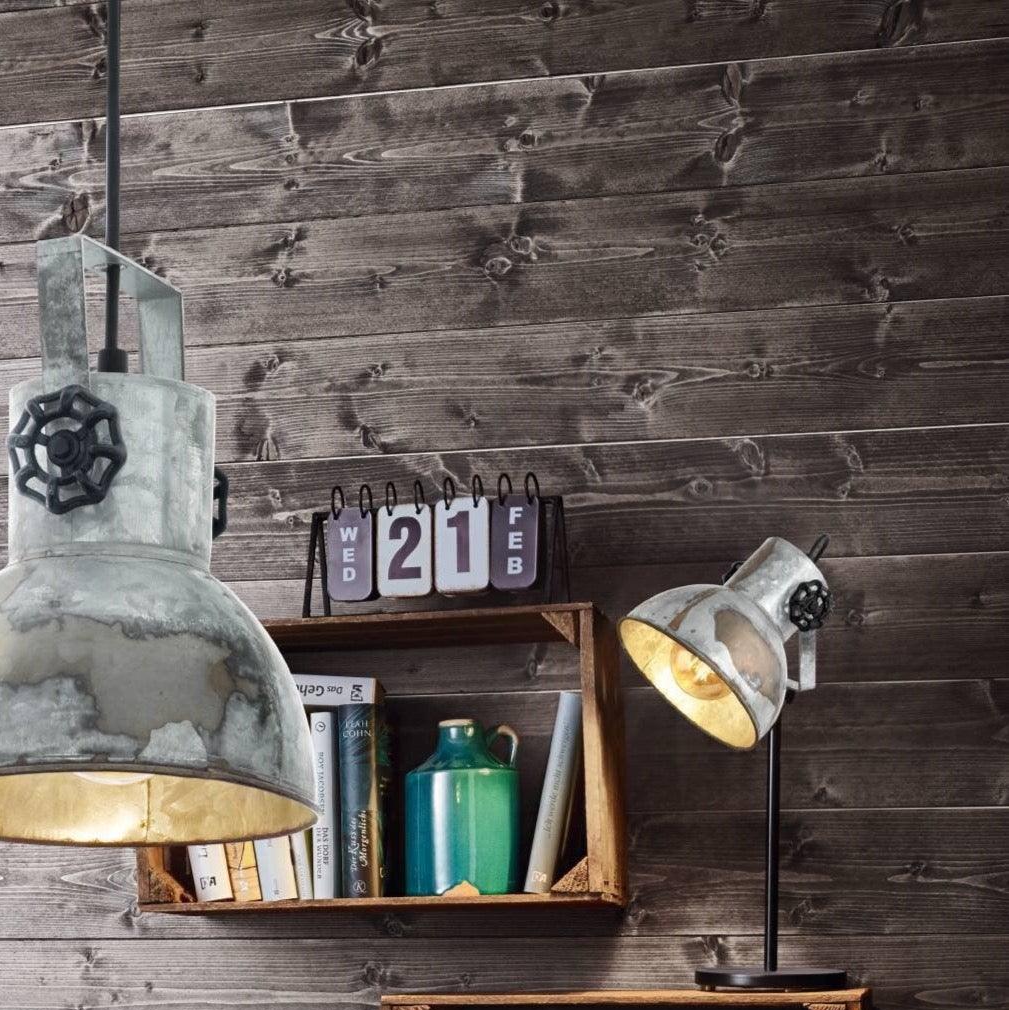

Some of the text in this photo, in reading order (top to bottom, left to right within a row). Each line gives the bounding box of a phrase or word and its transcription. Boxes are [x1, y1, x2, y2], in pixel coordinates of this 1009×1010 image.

[340, 526, 359, 582] WED
[506, 506, 524, 575] FEB
[296, 684, 343, 697] Das Geh
[342, 729, 372, 738] COHN
